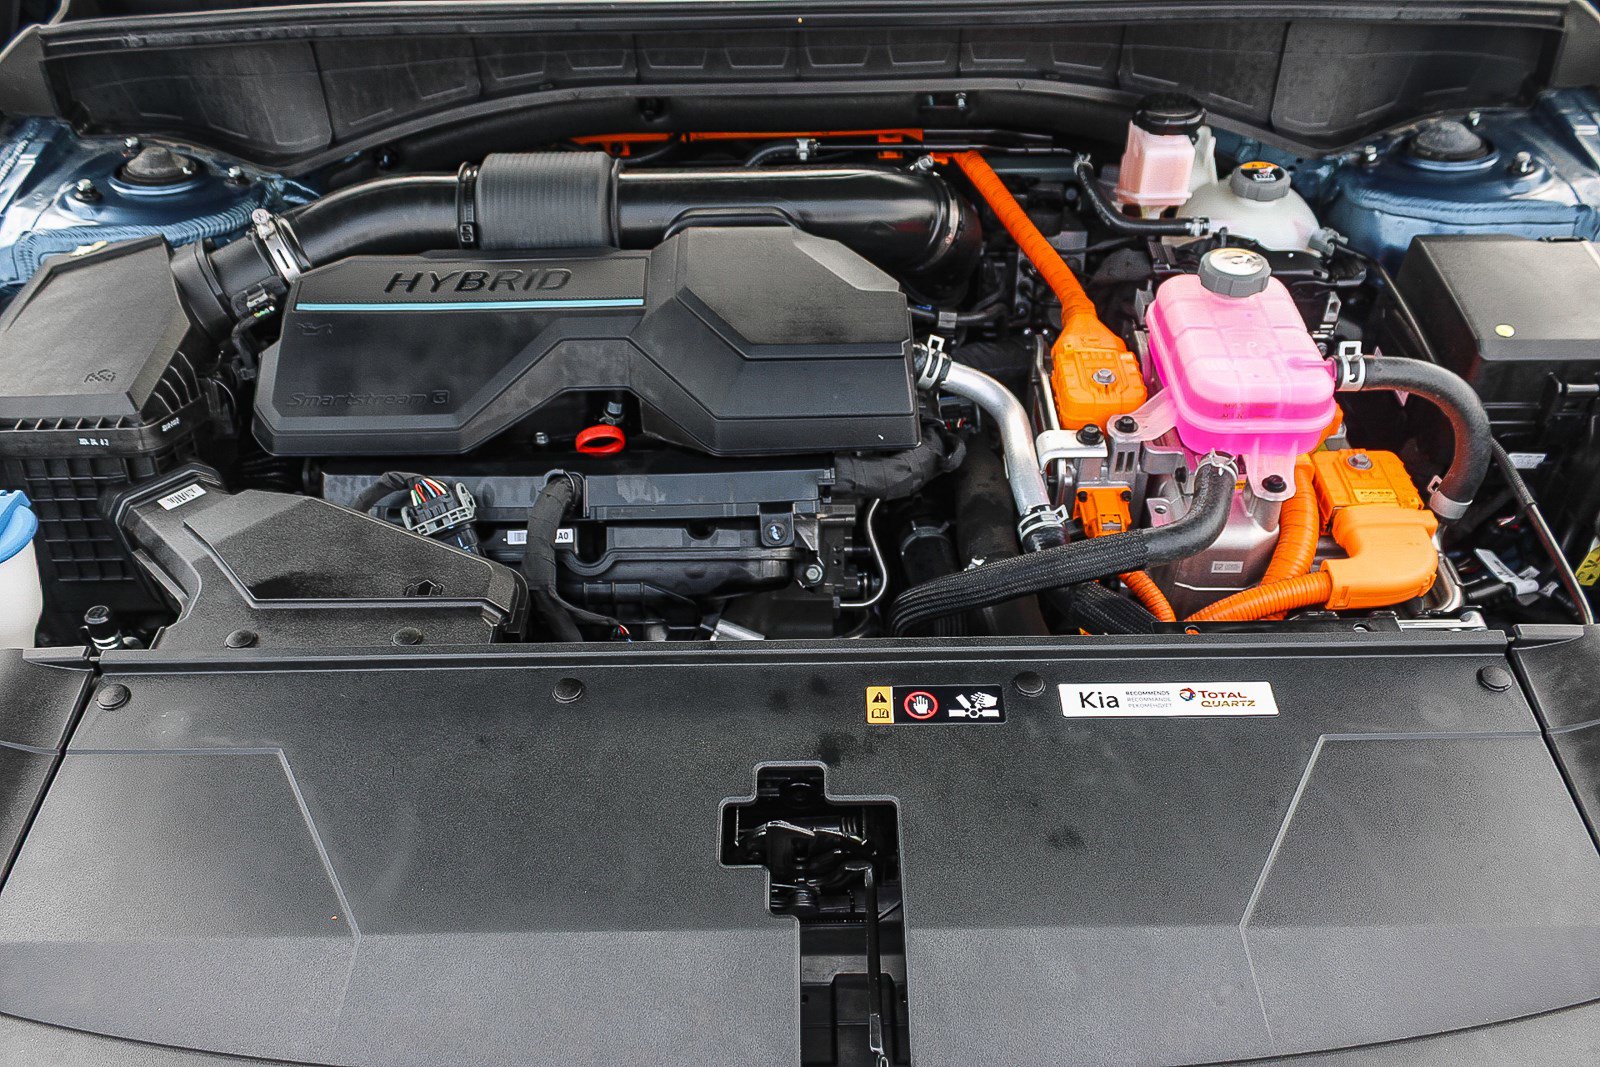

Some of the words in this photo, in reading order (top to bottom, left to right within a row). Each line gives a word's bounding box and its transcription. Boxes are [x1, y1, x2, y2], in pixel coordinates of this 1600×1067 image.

[383, 268, 573, 293] HYBRID
[287, 391, 427, 406] Smartstream
[1079, 691, 1120, 709] Kia
[1201, 700, 1256, 708] QUARTZ
